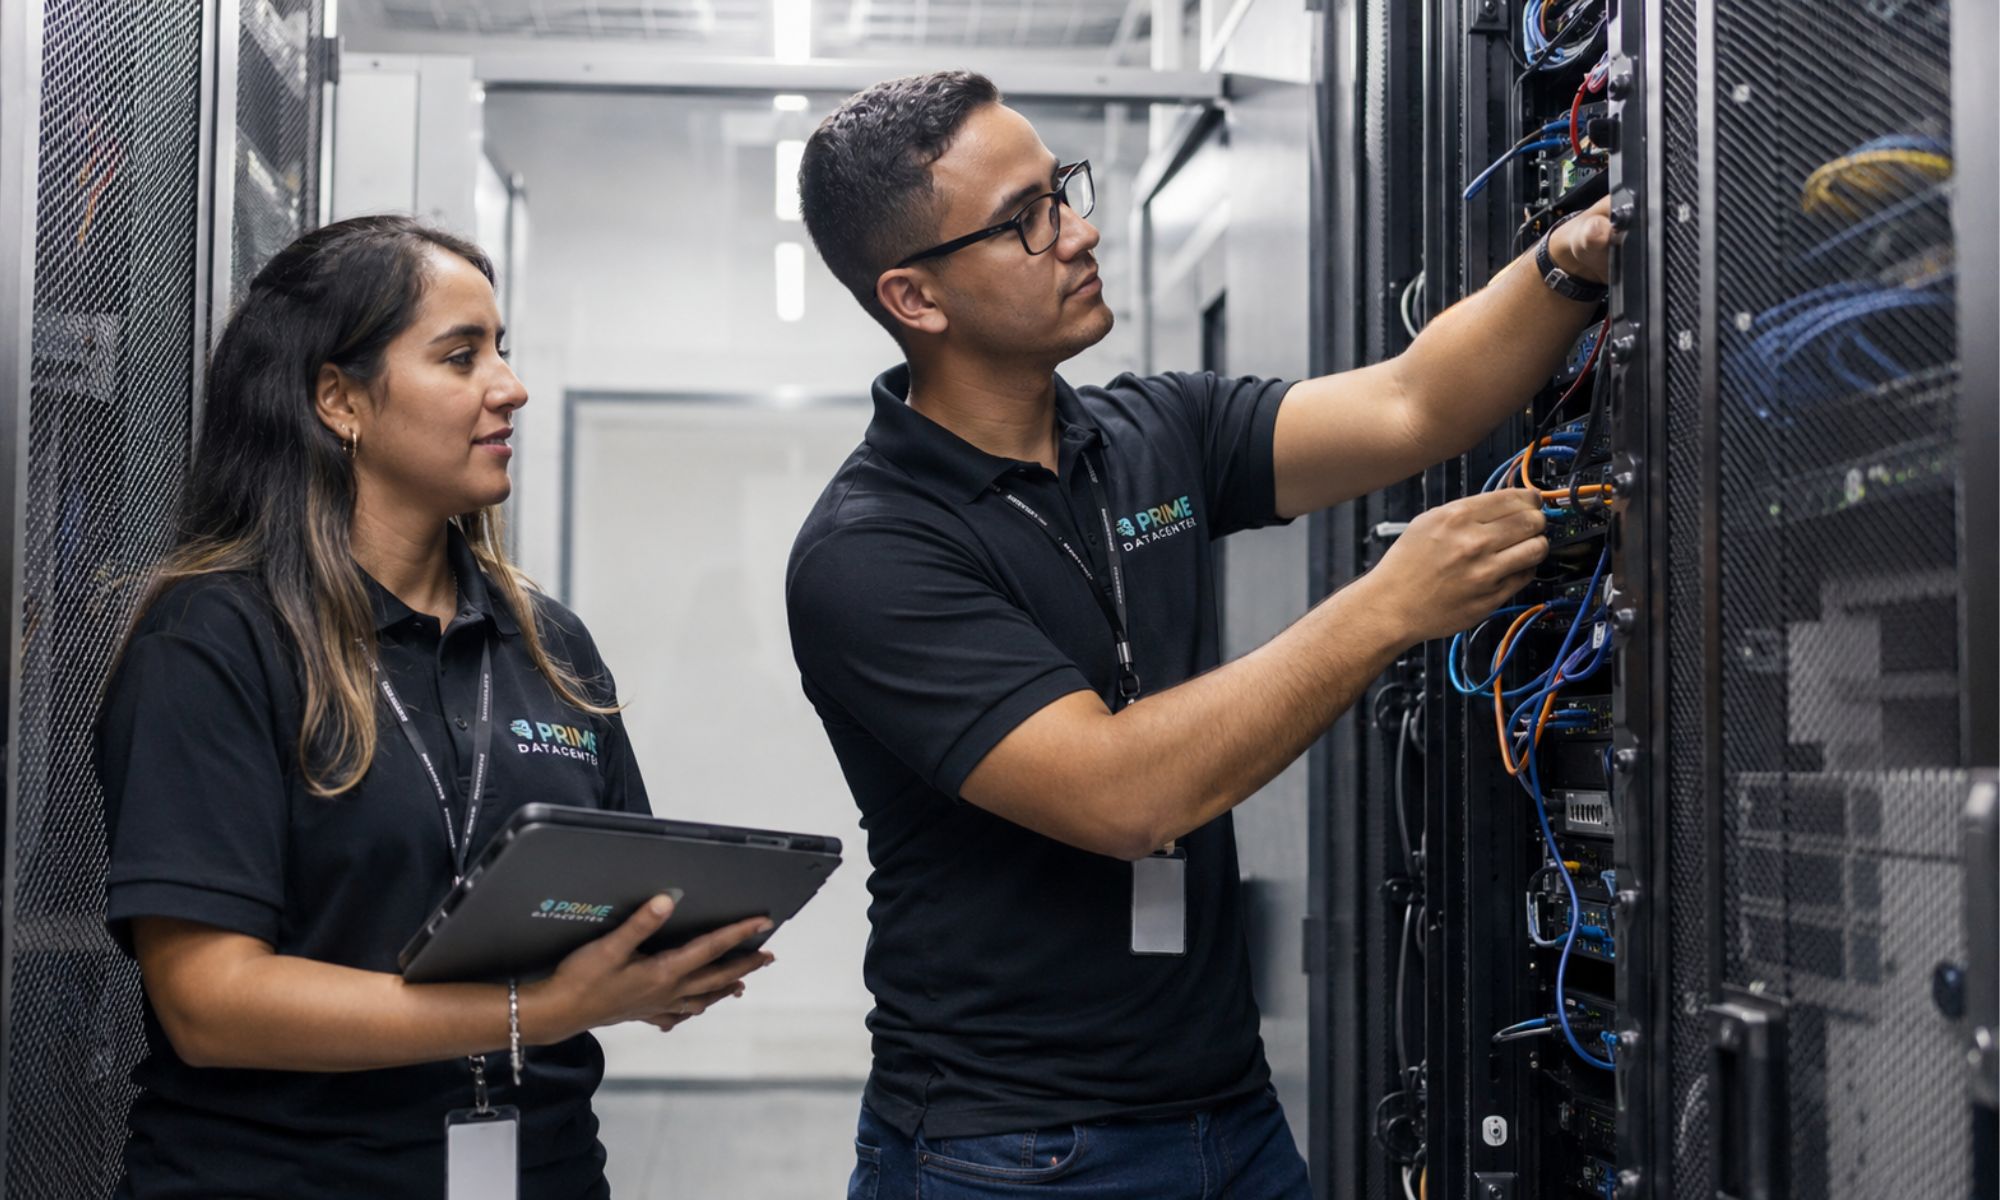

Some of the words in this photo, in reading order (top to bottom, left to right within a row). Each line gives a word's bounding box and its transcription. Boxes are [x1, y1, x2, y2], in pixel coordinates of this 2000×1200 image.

[1135, 495, 1193, 532] PRIME
[536, 722, 598, 755] PRIME
[554, 901, 614, 917] PRIME
